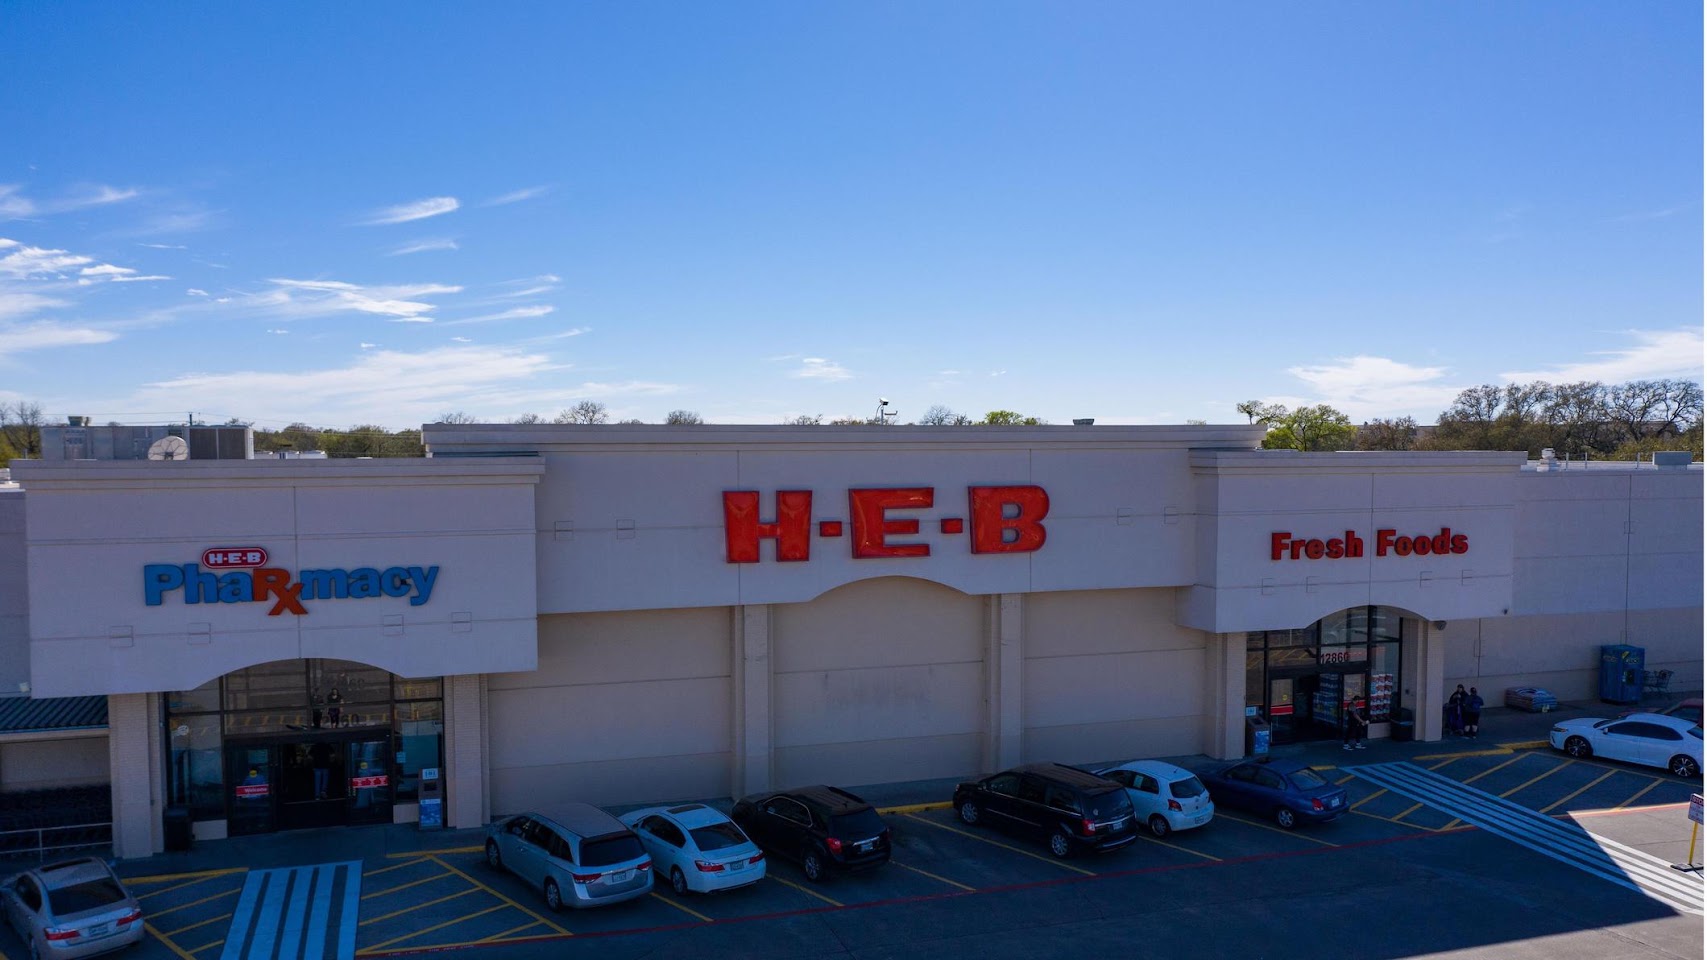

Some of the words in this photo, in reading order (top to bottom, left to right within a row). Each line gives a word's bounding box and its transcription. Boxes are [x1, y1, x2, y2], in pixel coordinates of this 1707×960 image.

[722, 485, 1050, 563] H-E-B
[1271, 530, 1364, 560] Fresh
[1376, 527, 1469, 556] Foods
[208, 552, 262, 565] H-E-B
[1320, 652, 1350, 664] 12860
[1692, 796, 1704, 805] STO
